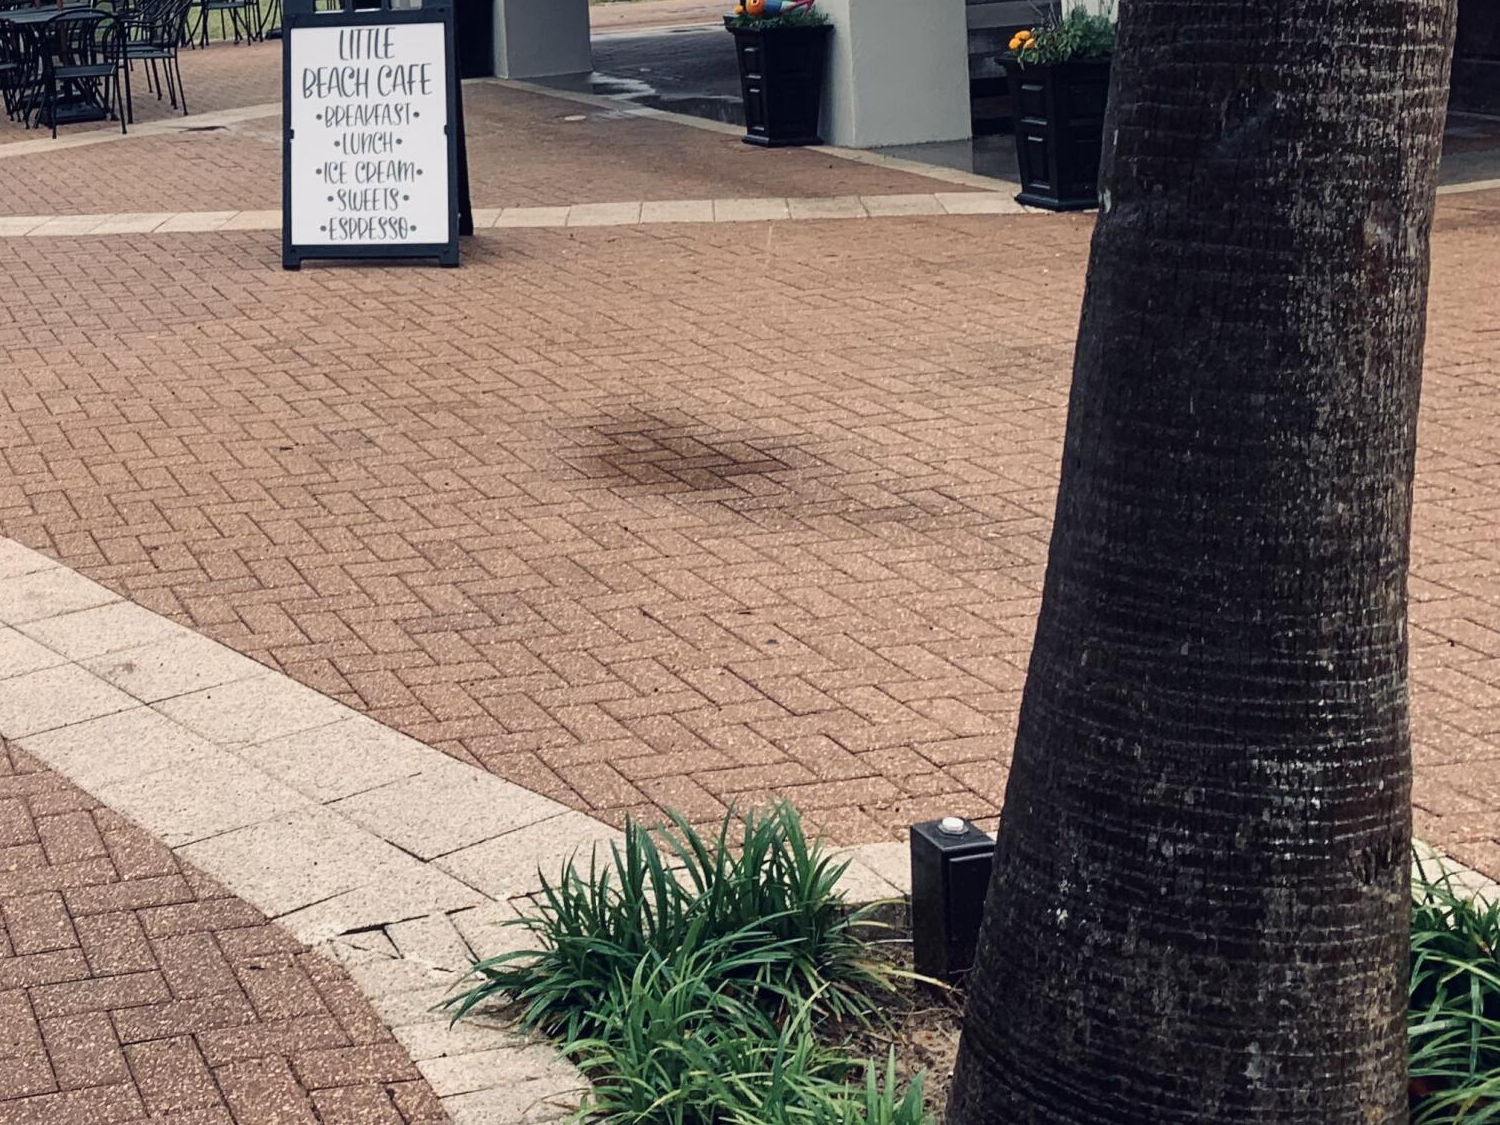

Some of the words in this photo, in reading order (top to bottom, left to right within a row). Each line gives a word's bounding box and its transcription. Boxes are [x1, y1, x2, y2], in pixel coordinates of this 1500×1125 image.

[339, 27, 396, 61] LITTLE
[302, 66, 369, 99] BEACH
[377, 63, 433, 97] CAFE
[324, 102, 412, 128] BREAKFAST
[323, 161, 348, 184] ICE
[355, 160, 415, 184] CREAM
[337, 188, 400, 212] SWEETS
[329, 216, 408, 241] ESPRESSO
